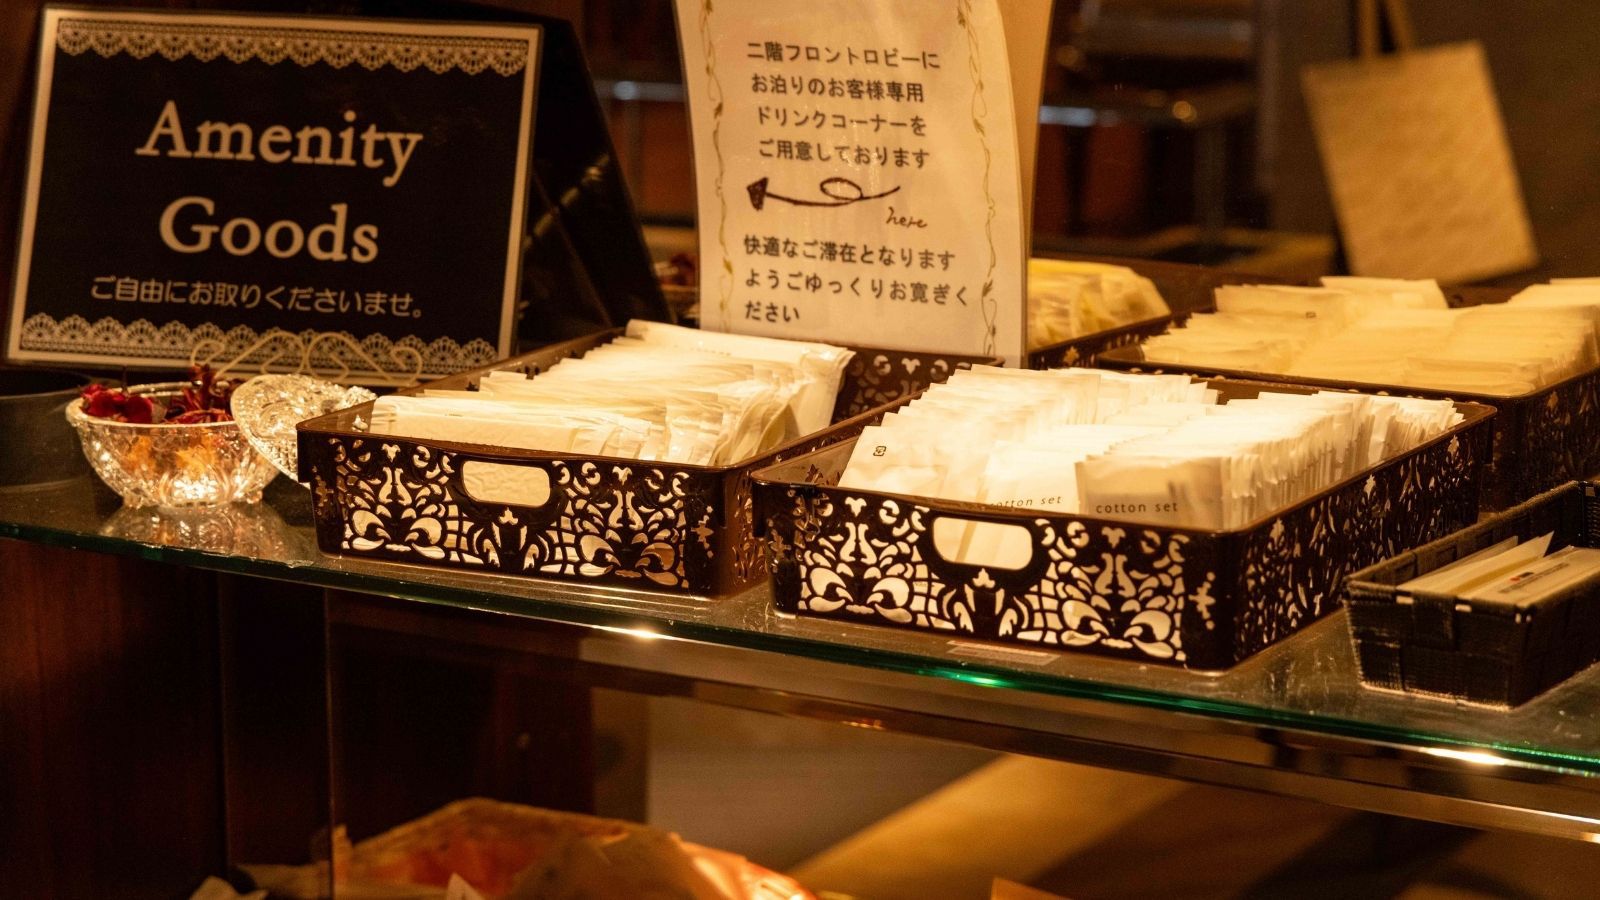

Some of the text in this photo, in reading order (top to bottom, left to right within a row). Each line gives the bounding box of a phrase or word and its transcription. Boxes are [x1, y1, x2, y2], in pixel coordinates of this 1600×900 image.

[746, 41, 941, 69] 二階フロントロビーに
[751, 73, 924, 102] お泊りのお客様専用
[758, 106, 927, 136] ドリンクコーナーを
[135, 99, 424, 188] Amenity
[759, 138, 930, 169] ご用意しております
[159, 196, 379, 263] Goods
[885, 206, 928, 228] here
[743, 234, 956, 271] 快適なご滞在となります
[90, 275, 422, 319] ご自由にお取りくださいませ。
[745, 268, 968, 307] ようごゆっくりお寛ぎく
[745, 300, 800, 323] ださい
[1040, 496, 1062, 506] set
[1095, 502, 1178, 514] cotton set
